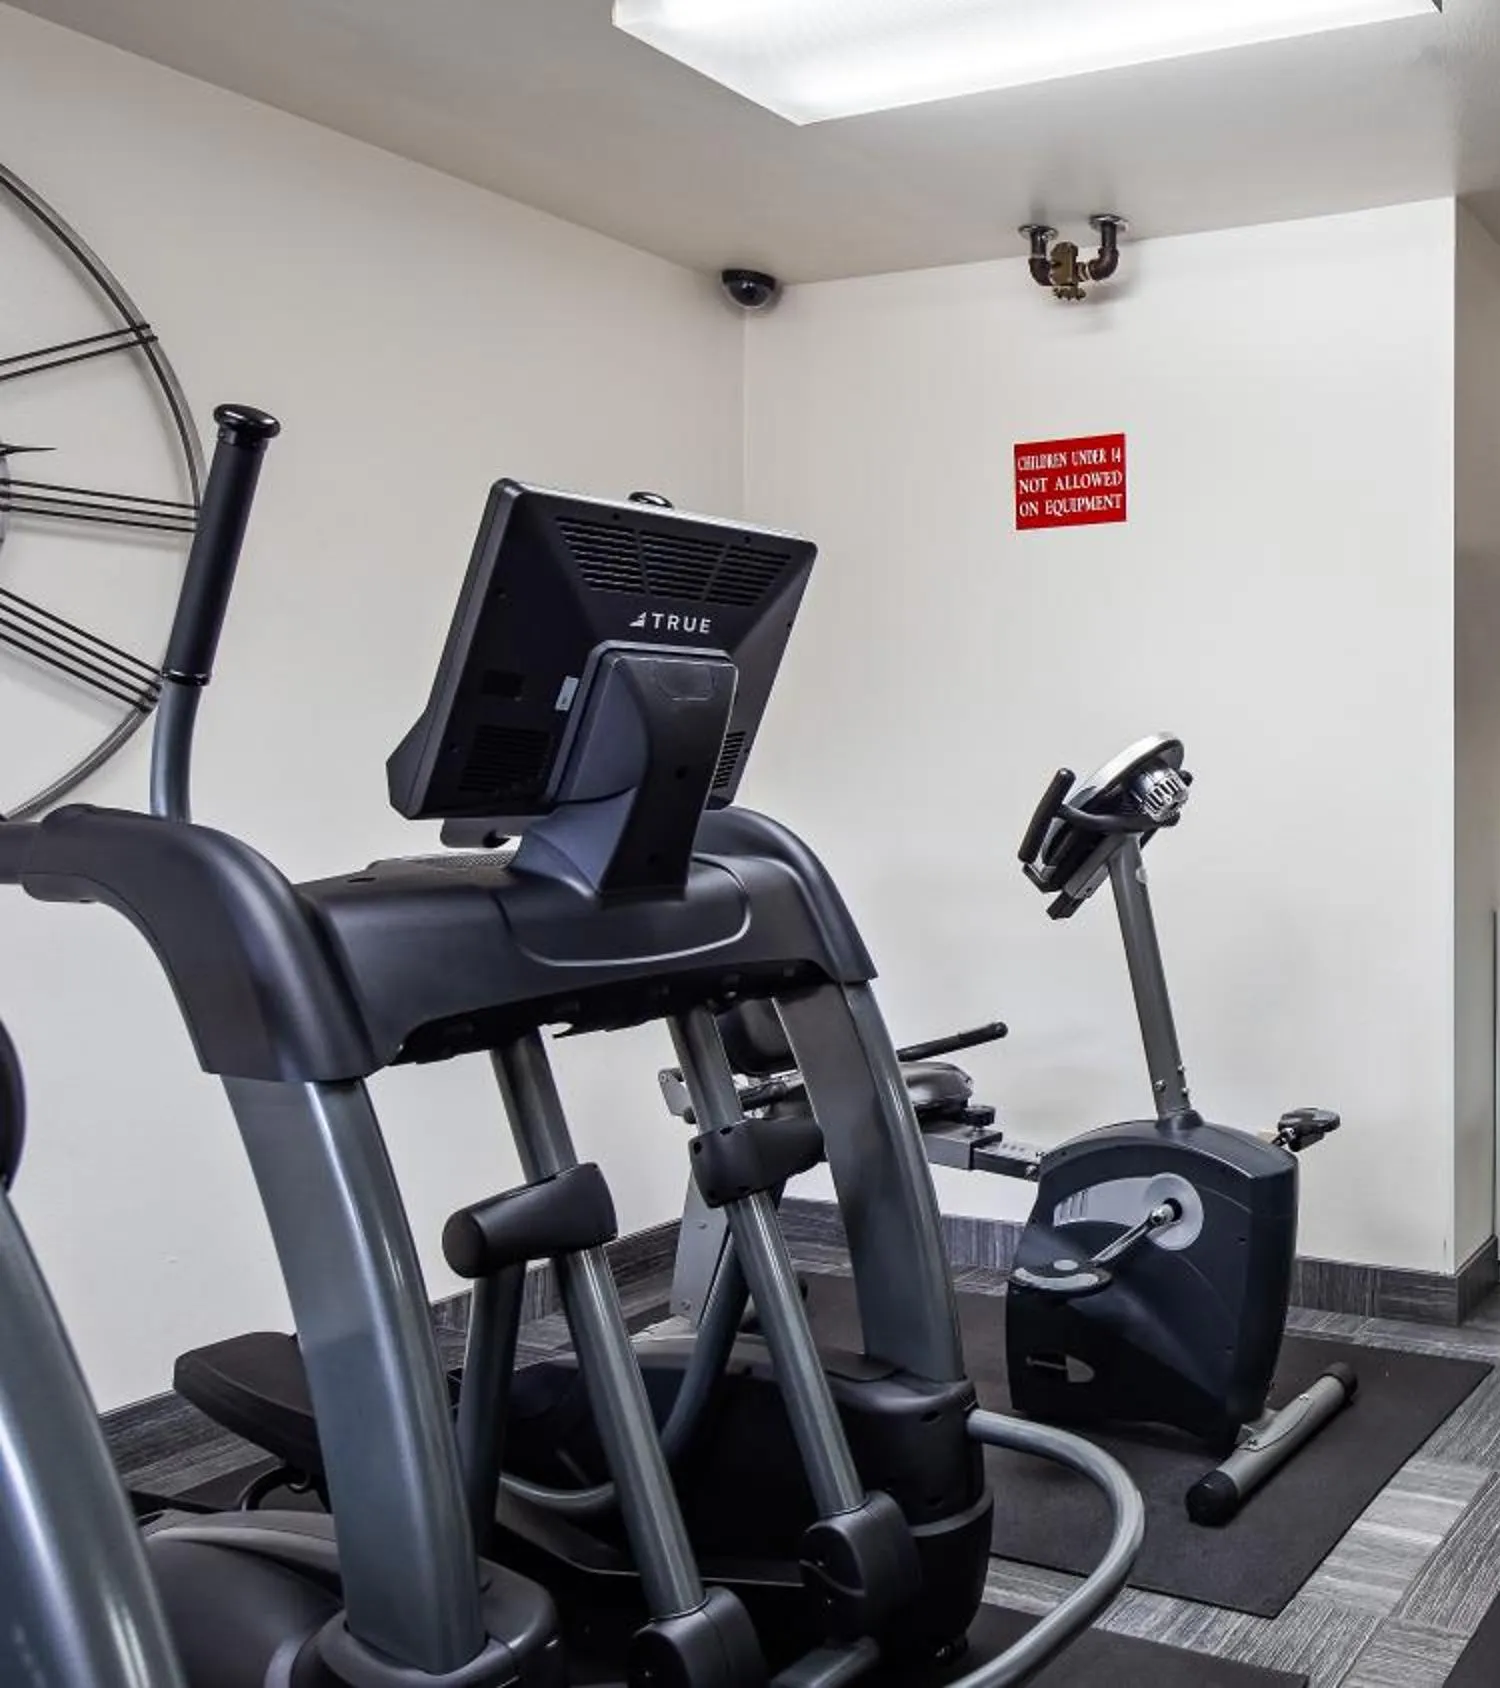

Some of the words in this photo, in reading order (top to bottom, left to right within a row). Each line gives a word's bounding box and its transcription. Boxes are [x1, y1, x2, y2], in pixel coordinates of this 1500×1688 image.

[1017, 452, 1067, 471] CHILDREN
[1071, 448, 1106, 466] UNDER
[1111, 447, 1121, 463] 14
[1018, 477, 1048, 494] NOT
[1055, 470, 1122, 491] ALLOWED
[1019, 501, 1039, 517] ON
[1045, 493, 1122, 516] EQUIPMENT
[651, 612, 712, 634] TRUE
